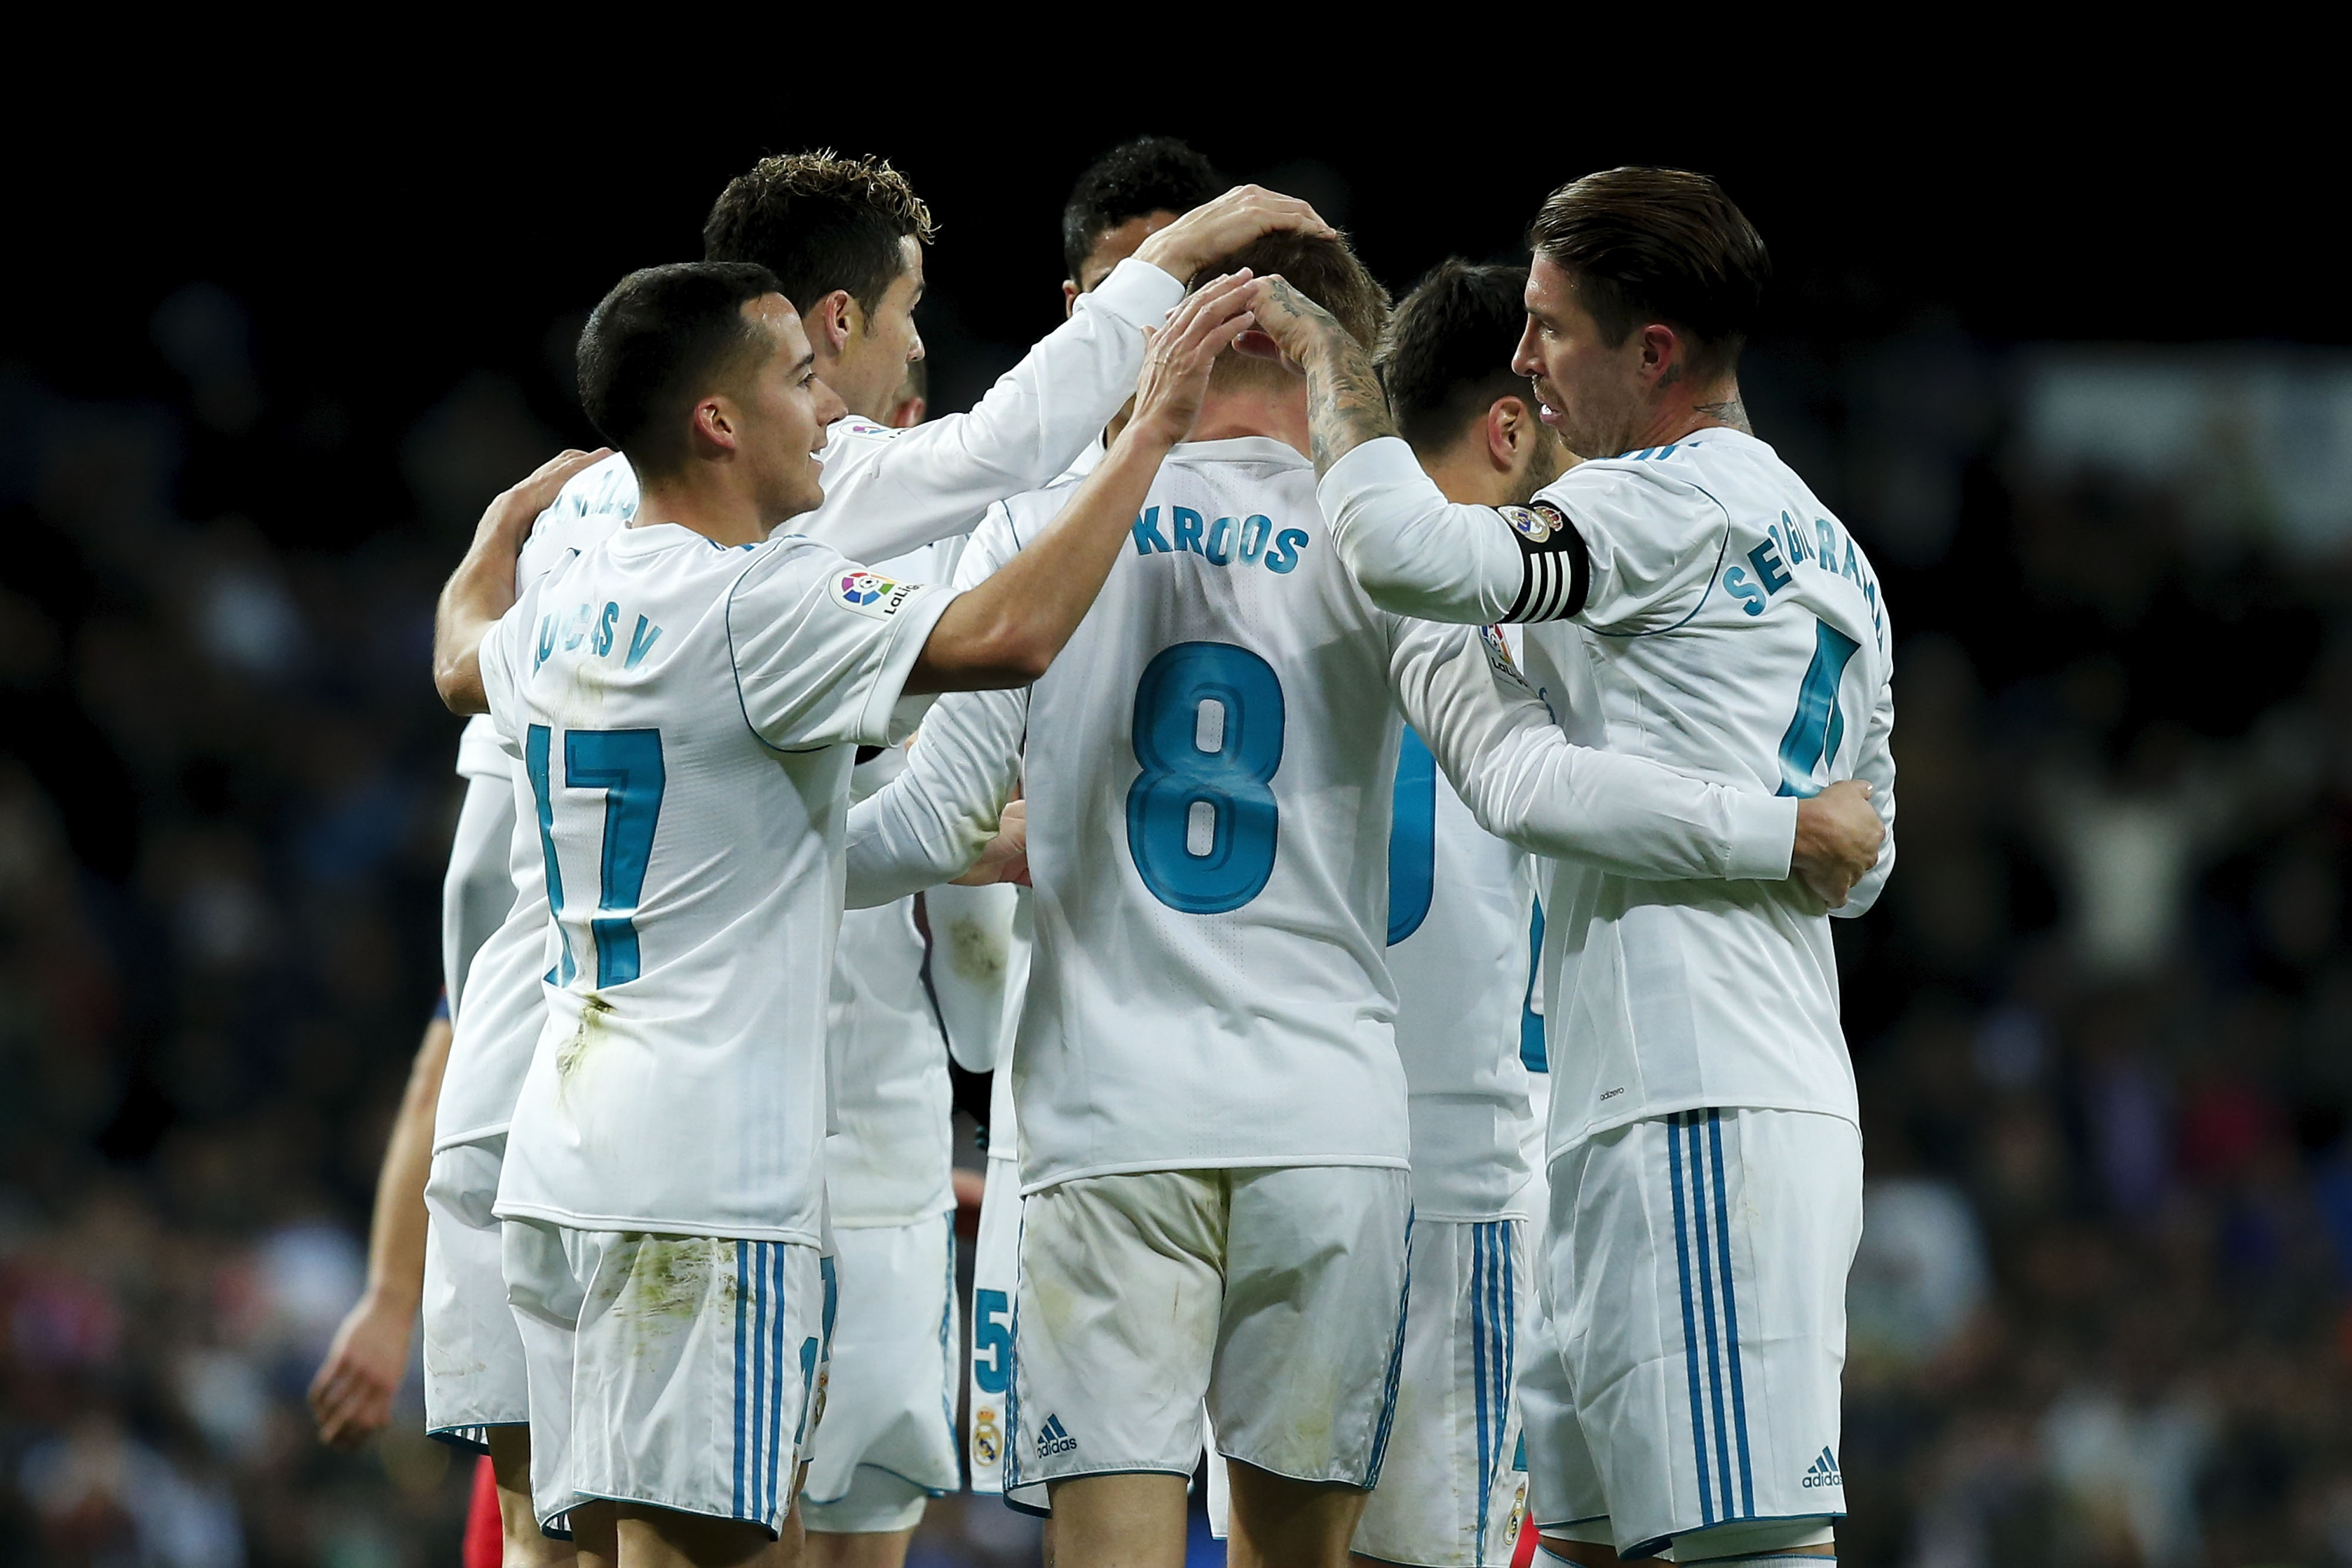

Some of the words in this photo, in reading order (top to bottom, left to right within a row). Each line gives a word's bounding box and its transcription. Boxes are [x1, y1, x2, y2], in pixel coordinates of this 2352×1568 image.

[1131, 505, 1309, 574] KROOS
[884, 584, 924, 615] LaLig
[1125, 641, 1285, 914] 8
[526, 724, 665, 989] 17
[1600, 1087, 1624, 1101] adizero
[975, 1289, 1011, 1393] 5
